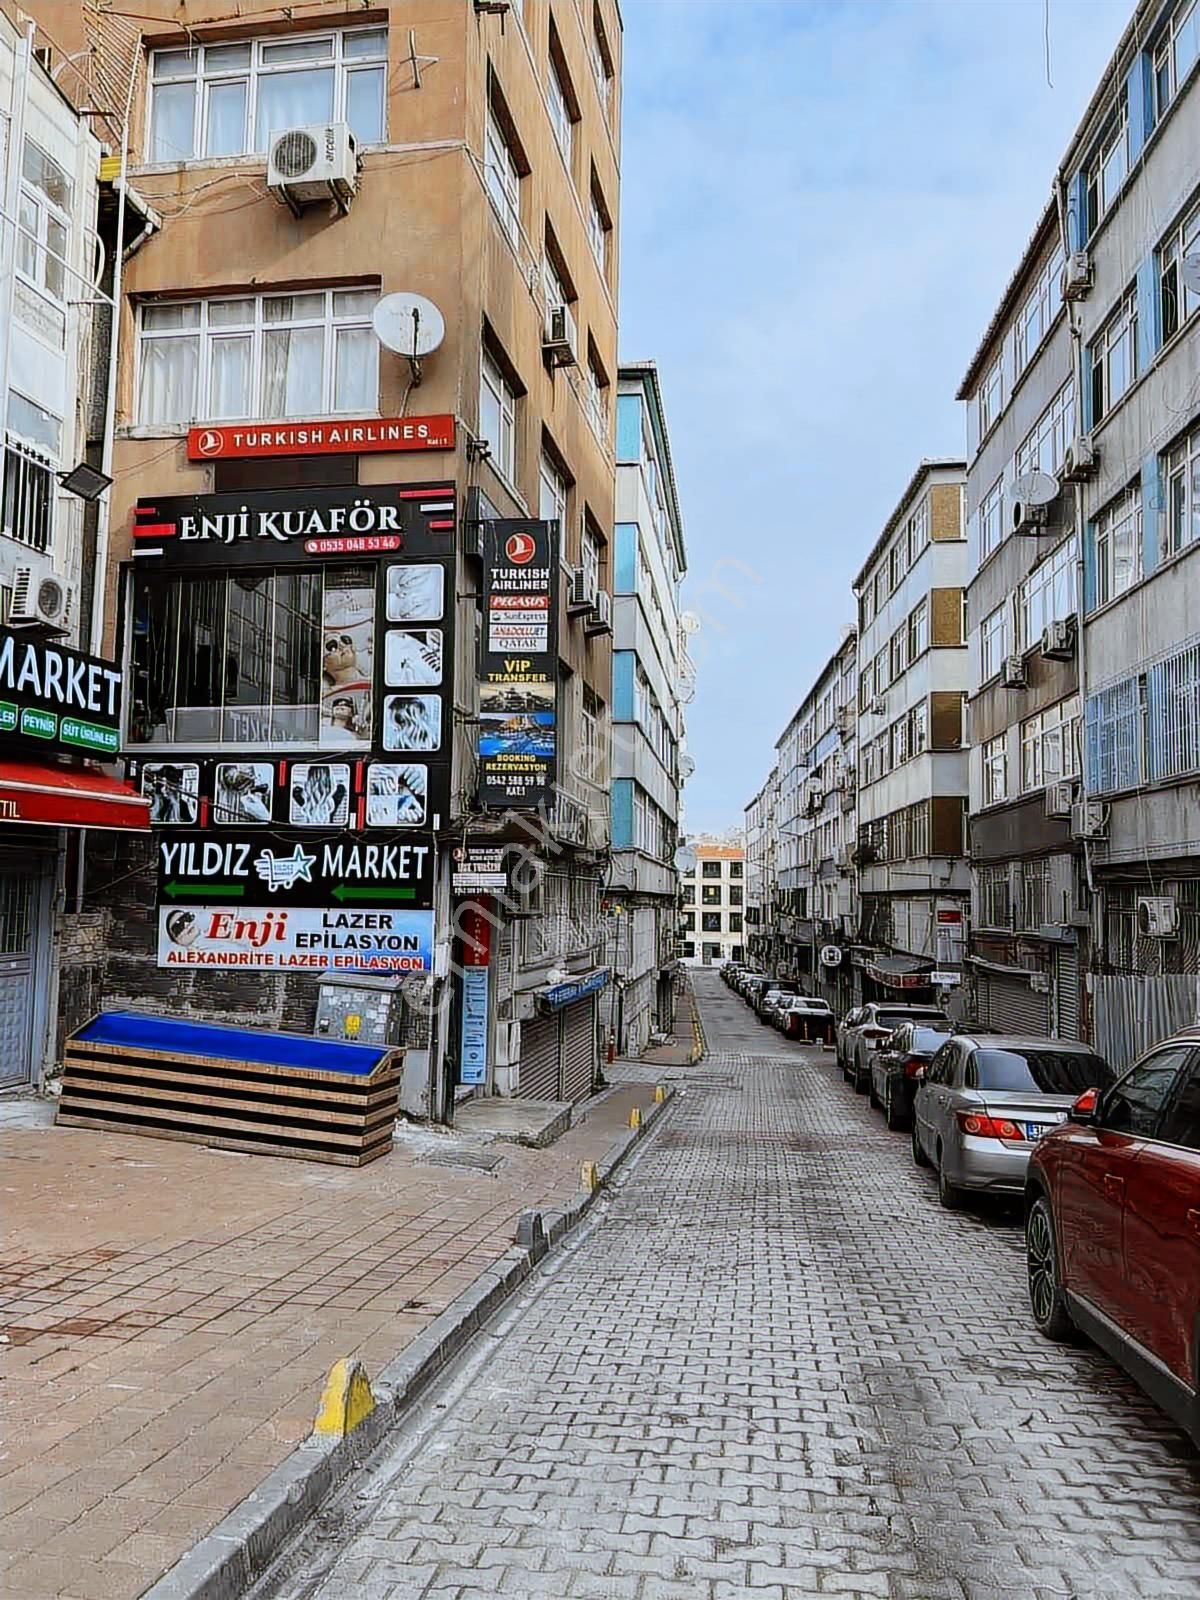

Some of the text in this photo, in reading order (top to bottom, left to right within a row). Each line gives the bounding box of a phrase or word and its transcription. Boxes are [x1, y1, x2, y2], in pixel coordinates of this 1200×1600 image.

[234, 425, 428, 447] TURKISH AIRLINES
[257, 500, 401, 541] KUAFÖR
[320, 539, 344, 553] 0535
[367, 538, 380, 550] 53
[382, 536, 396, 549] 46
[491, 568, 550, 579] TURKISH
[491, 580, 548, 590] AIRLINES
[492, 595, 547, 607] PEGASUS
[499, 640, 537, 649] QATAR
[0, 636, 121, 715] MARKET
[488, 673, 547, 682] TRANSFER
[23, 714, 55, 732] PEYNİR
[63, 722, 80, 737] SÜT
[486, 763, 547, 771] REZERVASYON
[160, 843, 429, 880] YILDIZ MARKET
[205, 911, 288, 948] Enji
[322, 912, 392, 930] LAZER
[295, 931, 418, 951] EPİLASYON
[167, 951, 424, 971] ALEXANDRİTE LAZER EPİLASYON
